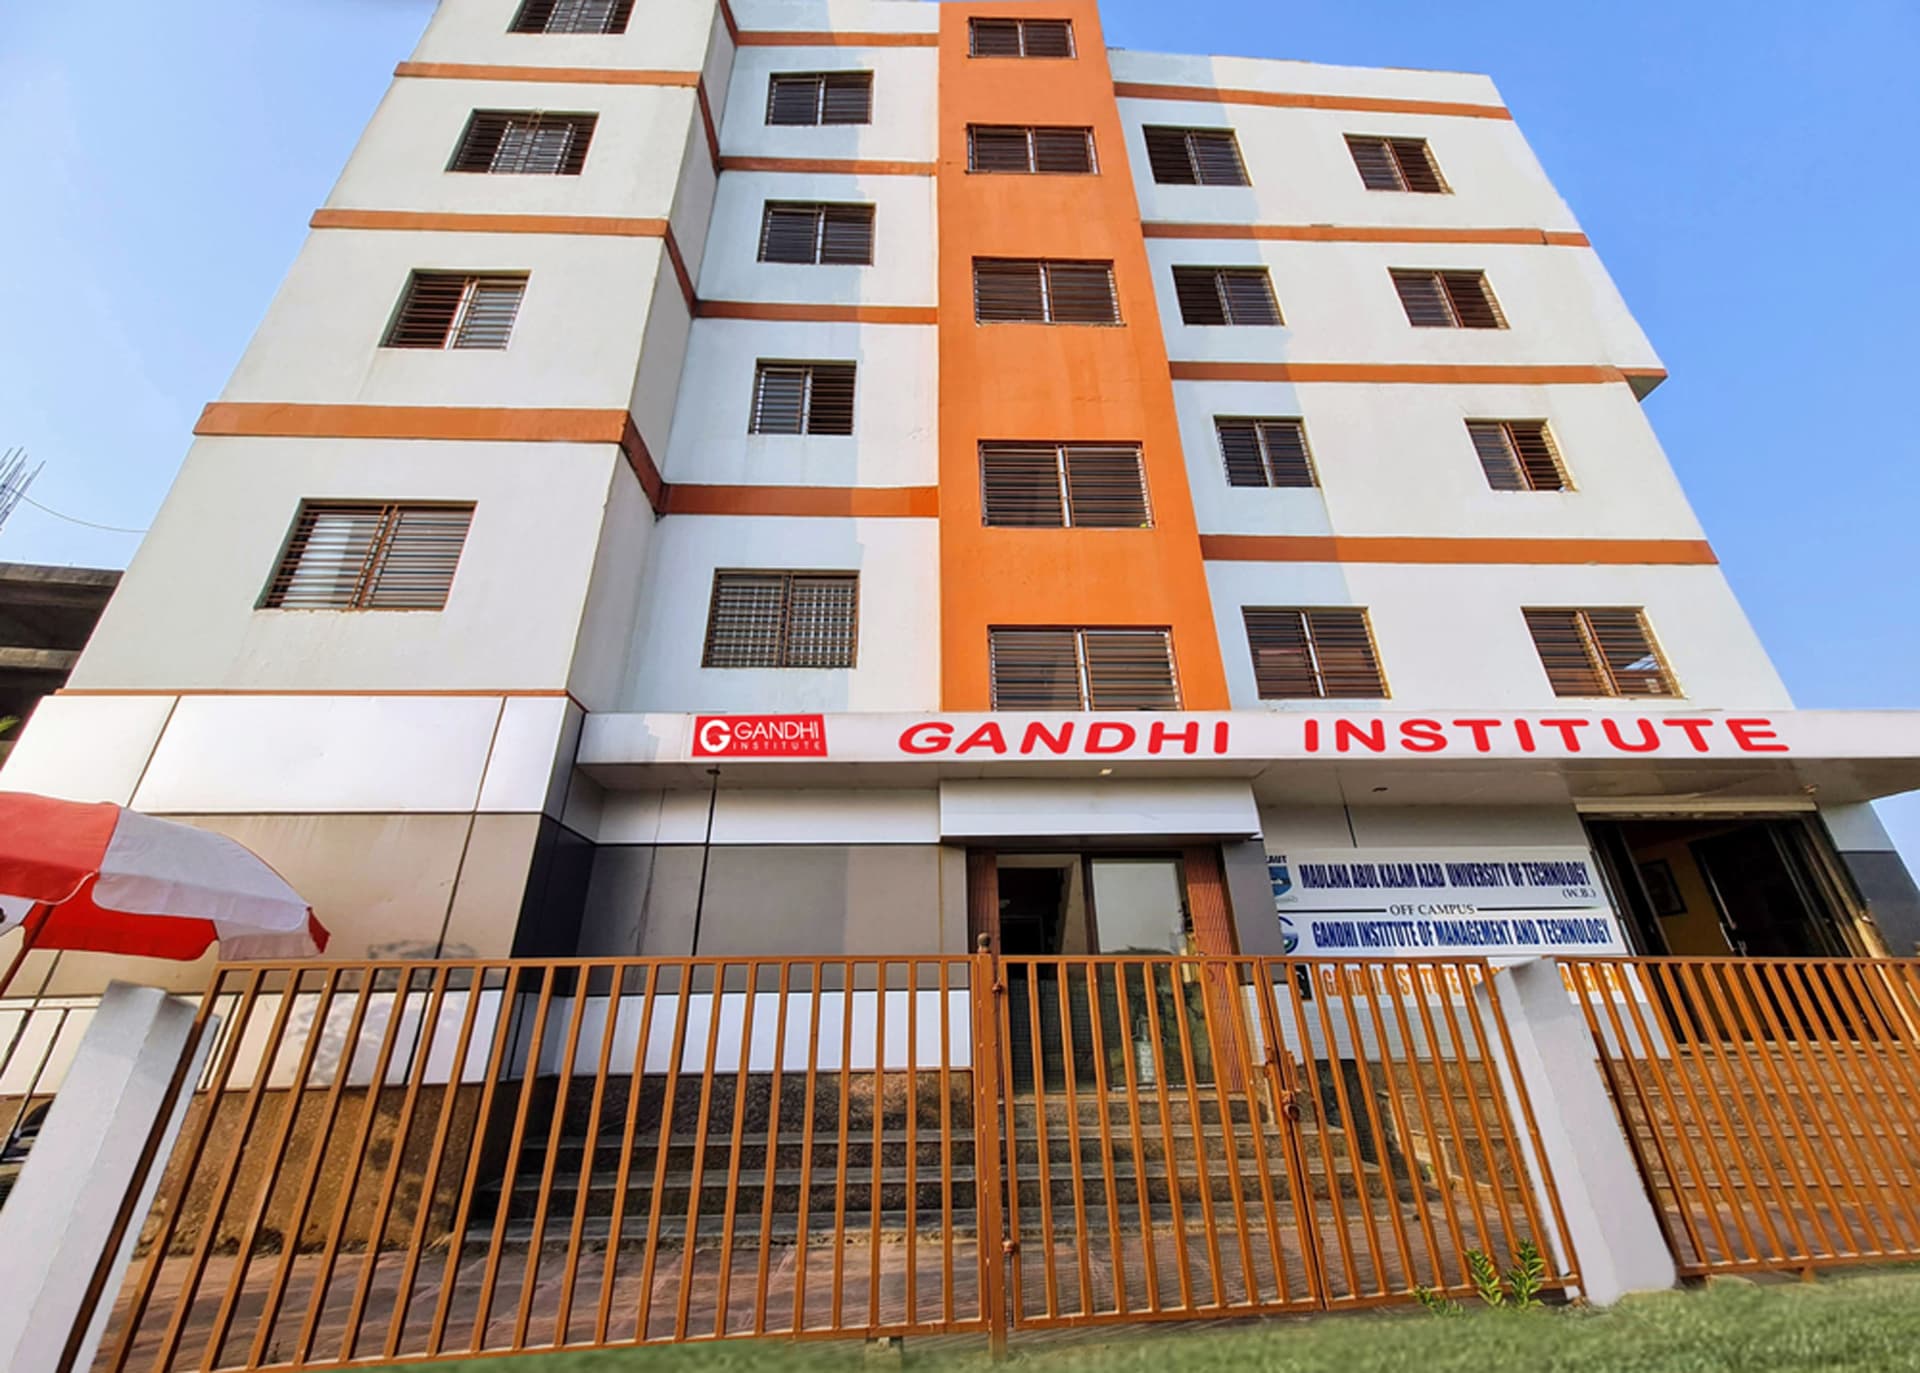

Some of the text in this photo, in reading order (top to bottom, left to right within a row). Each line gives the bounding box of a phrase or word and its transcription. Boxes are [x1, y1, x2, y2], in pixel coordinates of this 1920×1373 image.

[734, 721, 819, 740] GANDHI
[899, 718, 1790, 755] GANDHI INSTITUTE
[733, 741, 820, 751] INSTITUTE
[1298, 862, 1591, 888] MAULANA ABUL KALAM AZAD UNIVERSITY OF TECHNOLOGY
[1562, 888, 1597, 899] (W.B.)
[1389, 904, 1476, 916] OFF CAMPUS
[1312, 918, 1613, 948] GANDHI INSTITUTE OF MANAGEMENT AND TECHNOLOGY
